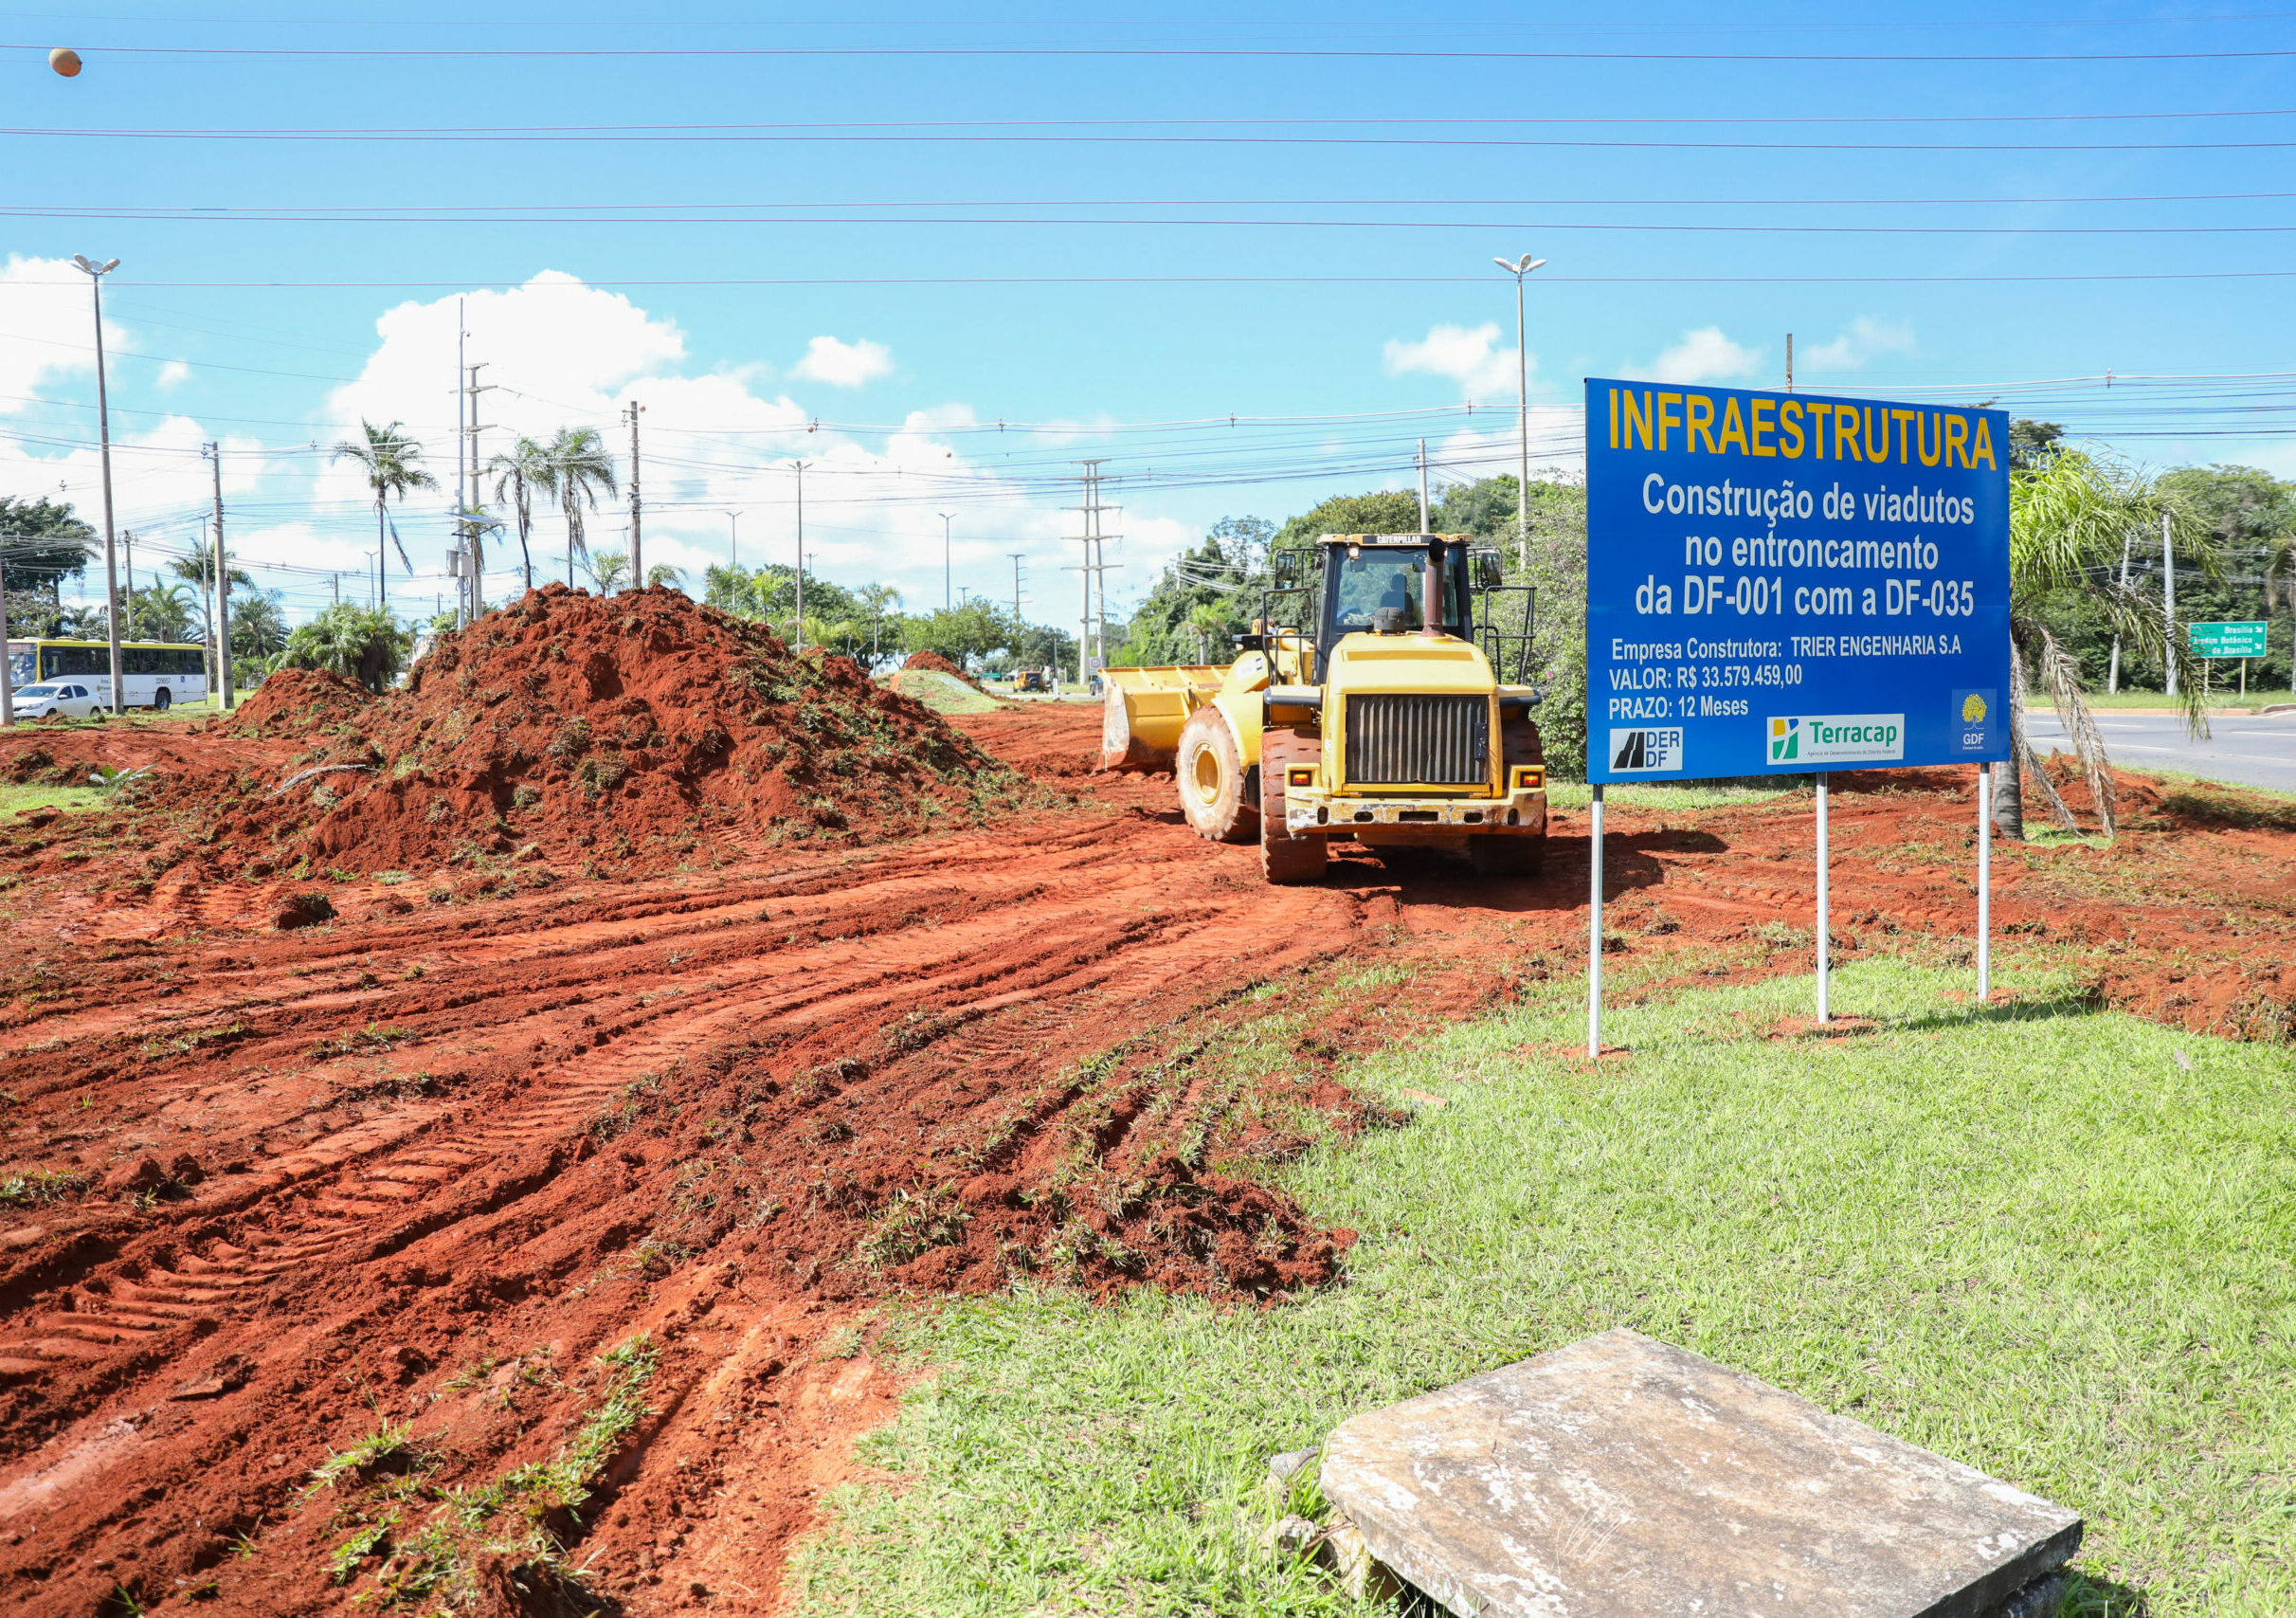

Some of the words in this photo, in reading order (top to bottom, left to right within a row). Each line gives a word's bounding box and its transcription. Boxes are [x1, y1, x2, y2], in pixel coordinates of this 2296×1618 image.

[1609, 389, 1997, 471] INFRAESTRUTURA
[1643, 473, 1813, 528] Construção
[1823, 482, 1855, 518] de
[1864, 485, 1975, 524] viadutos
[1377, 536, 1421, 544] CATERPILLAR
[1686, 536, 1723, 567] no
[1732, 535, 1939, 570] entroncamento
[1636, 575, 1672, 615] da
[1683, 575, 1782, 615] DF-001
[1795, 586, 1853, 615] com
[1862, 588, 1876, 616] a
[1886, 580, 1974, 617] DF-035
[1613, 639, 1682, 664] Empresa
[1687, 638, 1782, 660] Construtora:
[1791, 637, 1836, 657] TRIER
[1840, 635, 1936, 656] ENGENHARIA
[1939, 635, 1962, 655] S.A
[1609, 667, 1672, 691] VALOR:
[1676, 666, 1697, 690] R$
[1702, 664, 1802, 690] 33.579.459,00
[1609, 698, 1672, 719] PRAZO:
[1679, 698, 1695, 718] 12
[1701, 696, 1748, 717] Meses
[1646, 731, 1680, 748] DER
[1809, 721, 1897, 747] Terracap
[1963, 733, 1984, 745] GDF
[1645, 751, 1668, 768] DF
